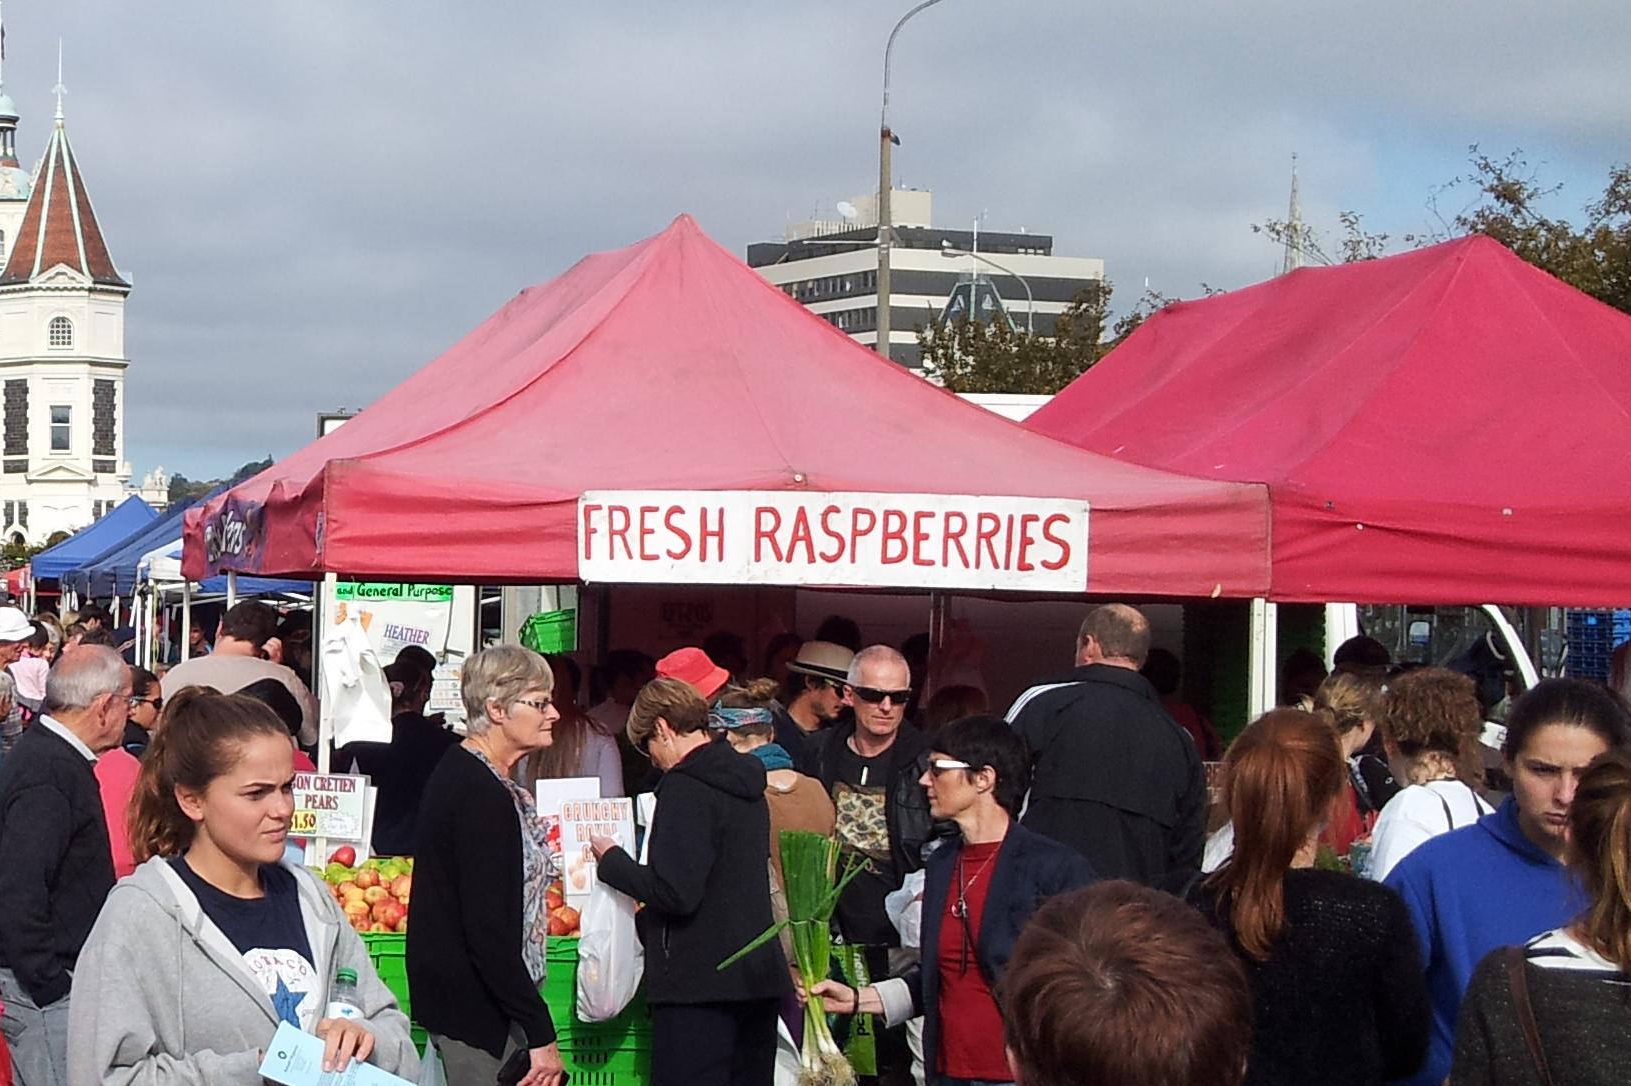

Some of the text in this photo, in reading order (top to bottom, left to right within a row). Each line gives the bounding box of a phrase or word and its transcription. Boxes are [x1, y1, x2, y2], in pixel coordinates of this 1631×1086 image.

[583, 504, 1071, 572] FRESH RASPBERRIES
[337, 585, 354, 595] and
[357, 583, 403, 597] General
[384, 624, 429, 644] HEATHER
[313, 777, 356, 793] CRETIEN
[305, 794, 339, 810] PEARS
[564, 802, 628, 821] CRUNCHY
